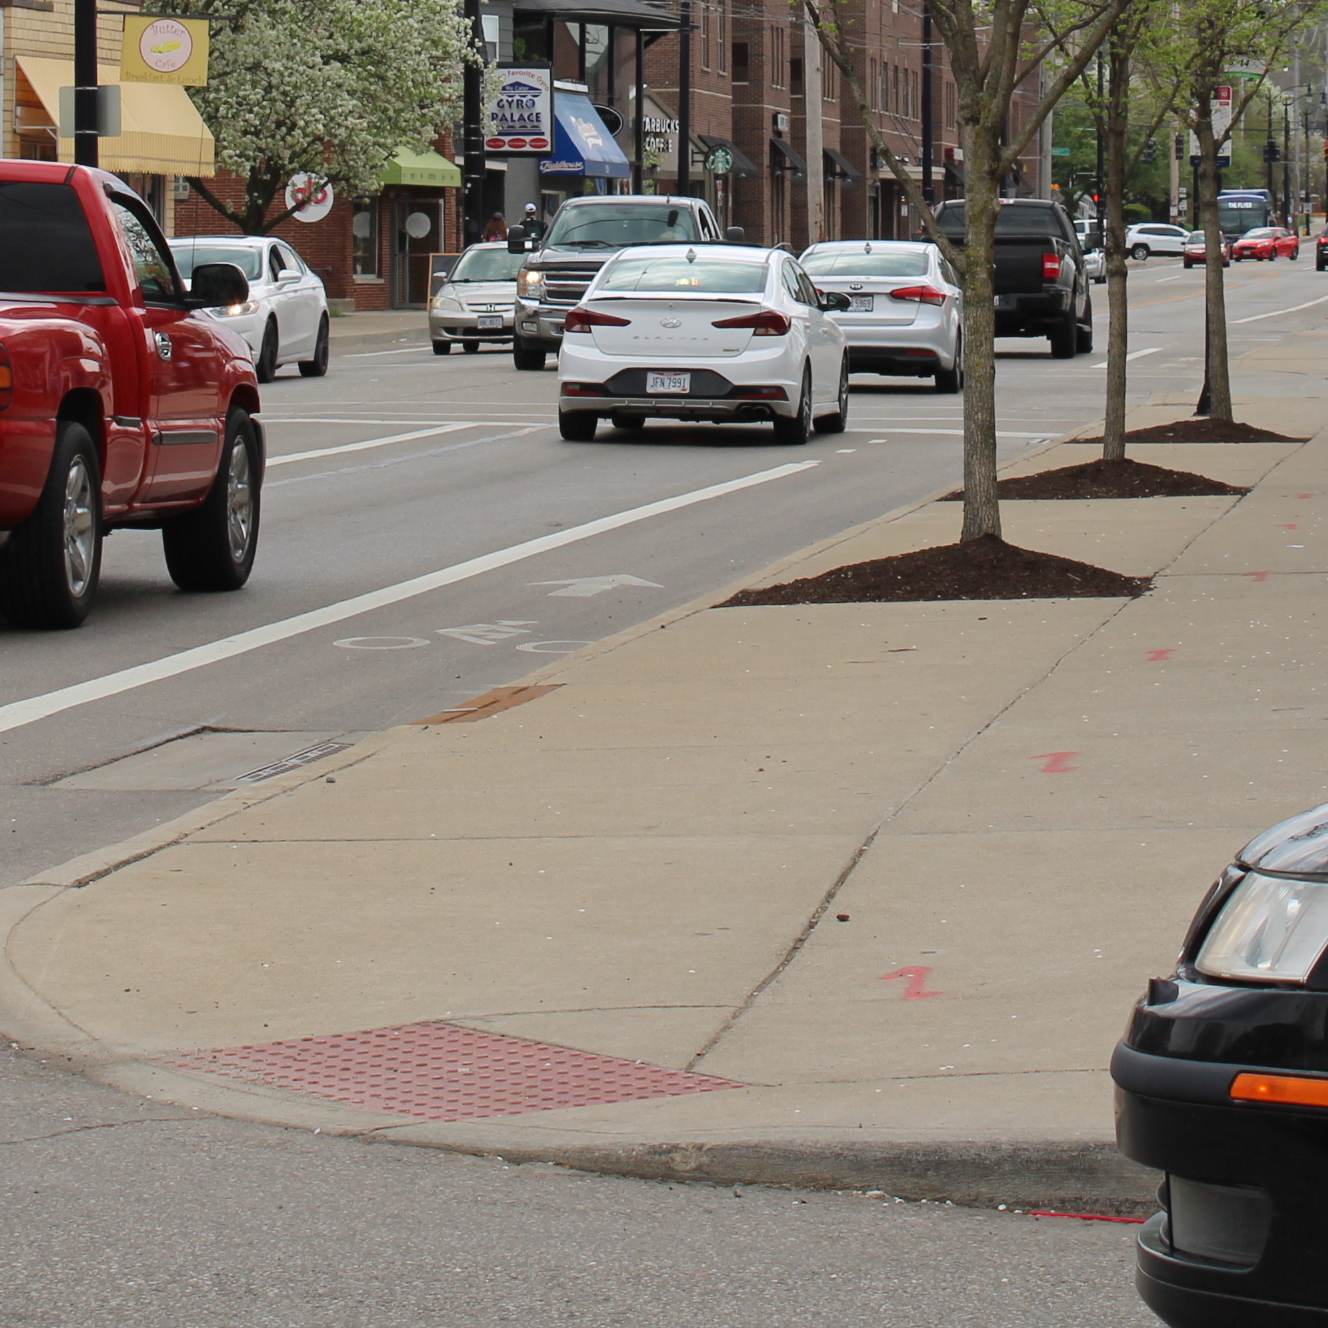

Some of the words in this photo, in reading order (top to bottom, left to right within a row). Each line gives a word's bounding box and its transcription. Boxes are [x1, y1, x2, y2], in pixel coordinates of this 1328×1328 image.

[151, 24, 187, 37] Butter
[125, 71, 163, 82] Breakfast
[177, 75, 205, 84] Lunch
[507, 70, 536, 79] Favorite
[537, 76, 550, 92] Gyro
[496, 99, 536, 109] GYRO
[491, 112, 542, 123] PALACE
[650, 377, 665, 388] JFN
[667, 377, 686, 389] 7991
